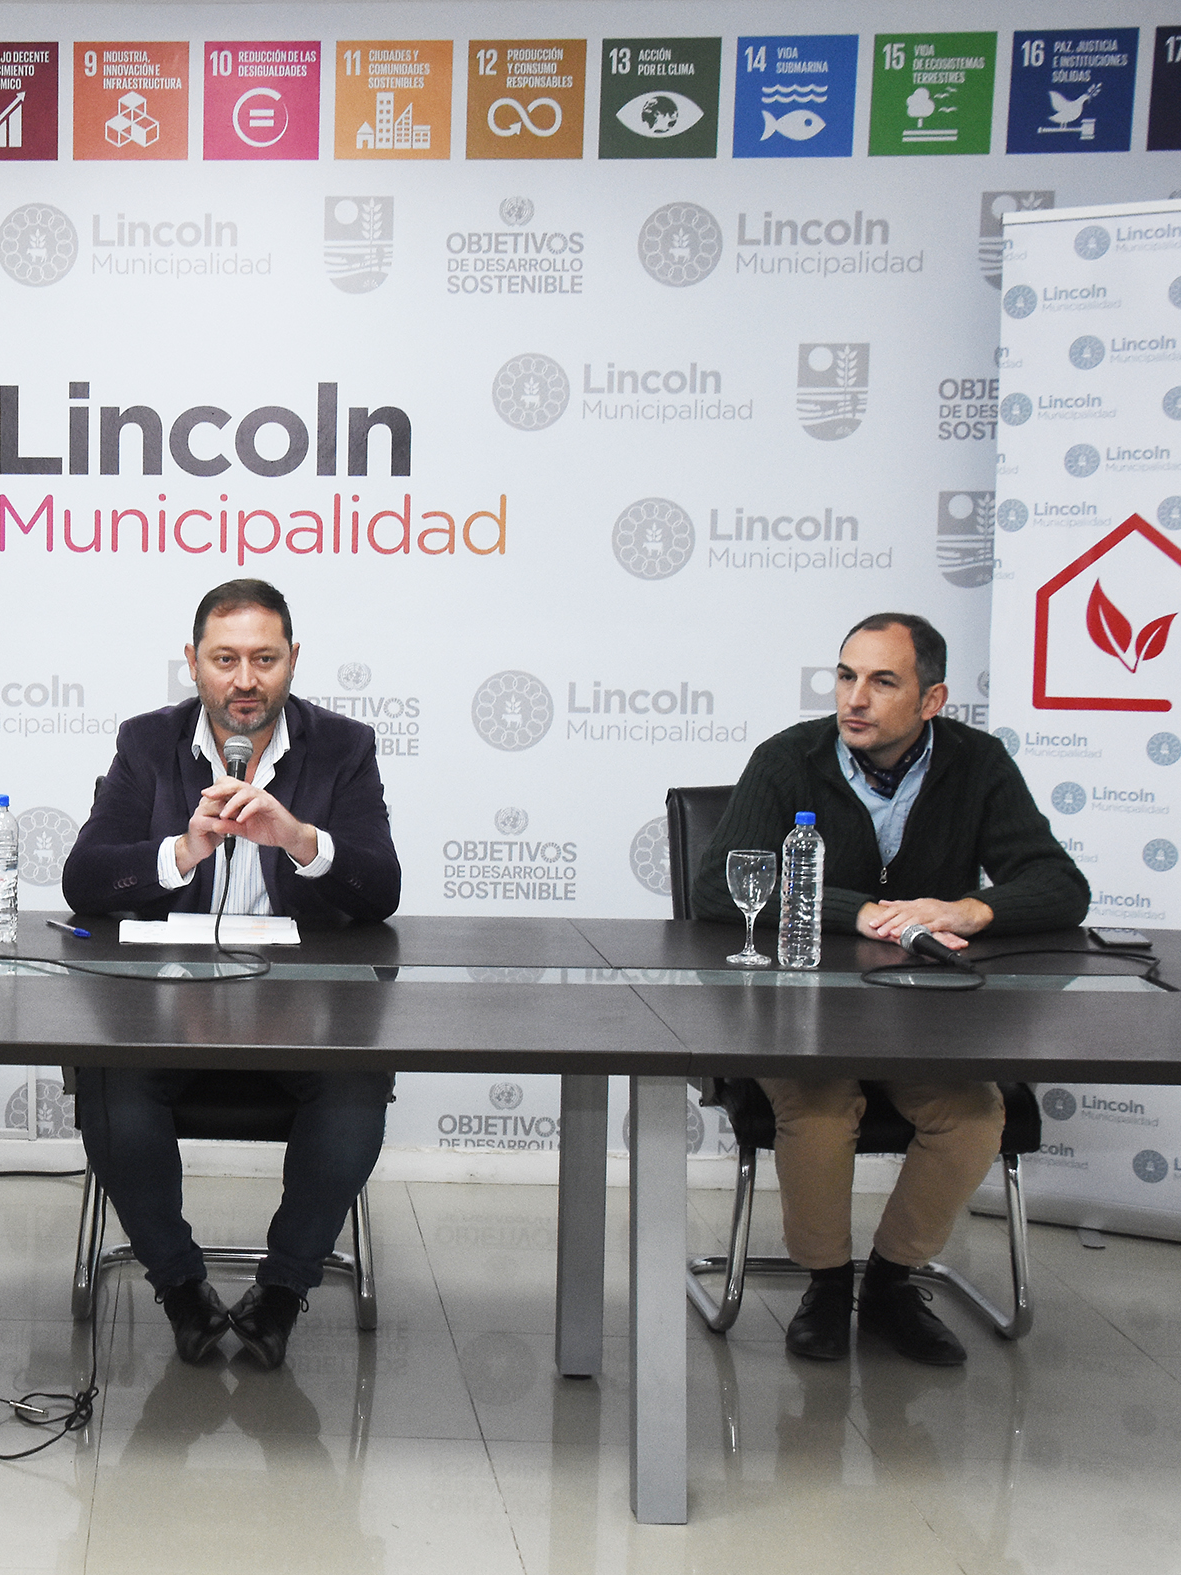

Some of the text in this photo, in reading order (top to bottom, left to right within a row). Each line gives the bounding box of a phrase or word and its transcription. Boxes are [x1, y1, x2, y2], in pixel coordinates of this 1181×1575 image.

[777, 47, 798, 59] VIDA
[914, 44, 935, 57] VIDA
[1020, 39, 1045, 67] 16
[1075, 39, 1118, 52] JUSTICIA
[13, 51, 49, 63] DECENTE
[238, 48, 317, 63] REDUCCIÓN DE LAS
[368, 50, 419, 62] CIUDADES Y
[507, 47, 564, 61] PRODUCCIÓN
[609, 47, 631, 75] 13
[638, 47, 671, 61] ACCIÓN
[744, 46, 767, 72] 14
[882, 43, 906, 70] 15
[1059, 54, 1129, 68] INSTITUCIONES
[84, 51, 97, 77] 9
[103, 62, 154, 76] INNOVACIÓN
[209, 50, 232, 77] 10
[343, 50, 362, 76] 11
[369, 63, 430, 76] COMUNIDADES
[476, 49, 497, 76] 12
[507, 62, 557, 75] Y CONSUMO
[637, 63, 695, 76] POR EL CLIMA
[776, 61, 829, 73] SUBMARINA
[912, 57, 986, 70] DE ECOSISTEMAS
[238, 65, 308, 77] DESIGUALDADES
[913, 71, 966, 84] TERRESTRES
[1051, 69, 1091, 83] SÓLIDAS
[103, 78, 182, 90] INFRAESTRUCTURA
[368, 76, 424, 89] SOSTENIBLES
[506, 75, 573, 88] RESPONSABLES
[93, 213, 237, 247] Lincoln
[738, 210, 889, 245] Lincoln
[447, 232, 584, 255] OBJETIVOS
[92, 253, 271, 278] Municipalidad
[448, 258, 583, 272] DE DESARROLLO
[737, 250, 924, 277] Municipalidad
[448, 275, 583, 294] SOSTENIBLE
[1043, 284, 1107, 301] Lincoln
[1111, 336, 1176, 352] Lincoln
[584, 363, 721, 394] Lincoln
[1039, 394, 1102, 409] Lincoln
[583, 399, 753, 423] Municipalidad
[0, 382, 411, 477] Lincoln
[1106, 446, 1170, 461] Lincoln
[1034, 502, 1097, 516] Lincoln
[0, 493, 506, 566] Municipalidad
[710, 508, 859, 541] Lincoln
[709, 546, 893, 572] Municipalidad
[569, 681, 714, 715] Lincoln
[567, 720, 747, 745] Municipalidad
[1026, 732, 1087, 746] Lincoln
[1093, 787, 1155, 802] Lincoln
[443, 841, 577, 865] OBJETIVOS
[444, 865, 576, 880] DE DESARROLLO
[444, 881, 575, 900] SOSTENIBLE
[1081, 1095, 1144, 1114] Lincoln
[438, 1114, 560, 1137] OBJETIVO
